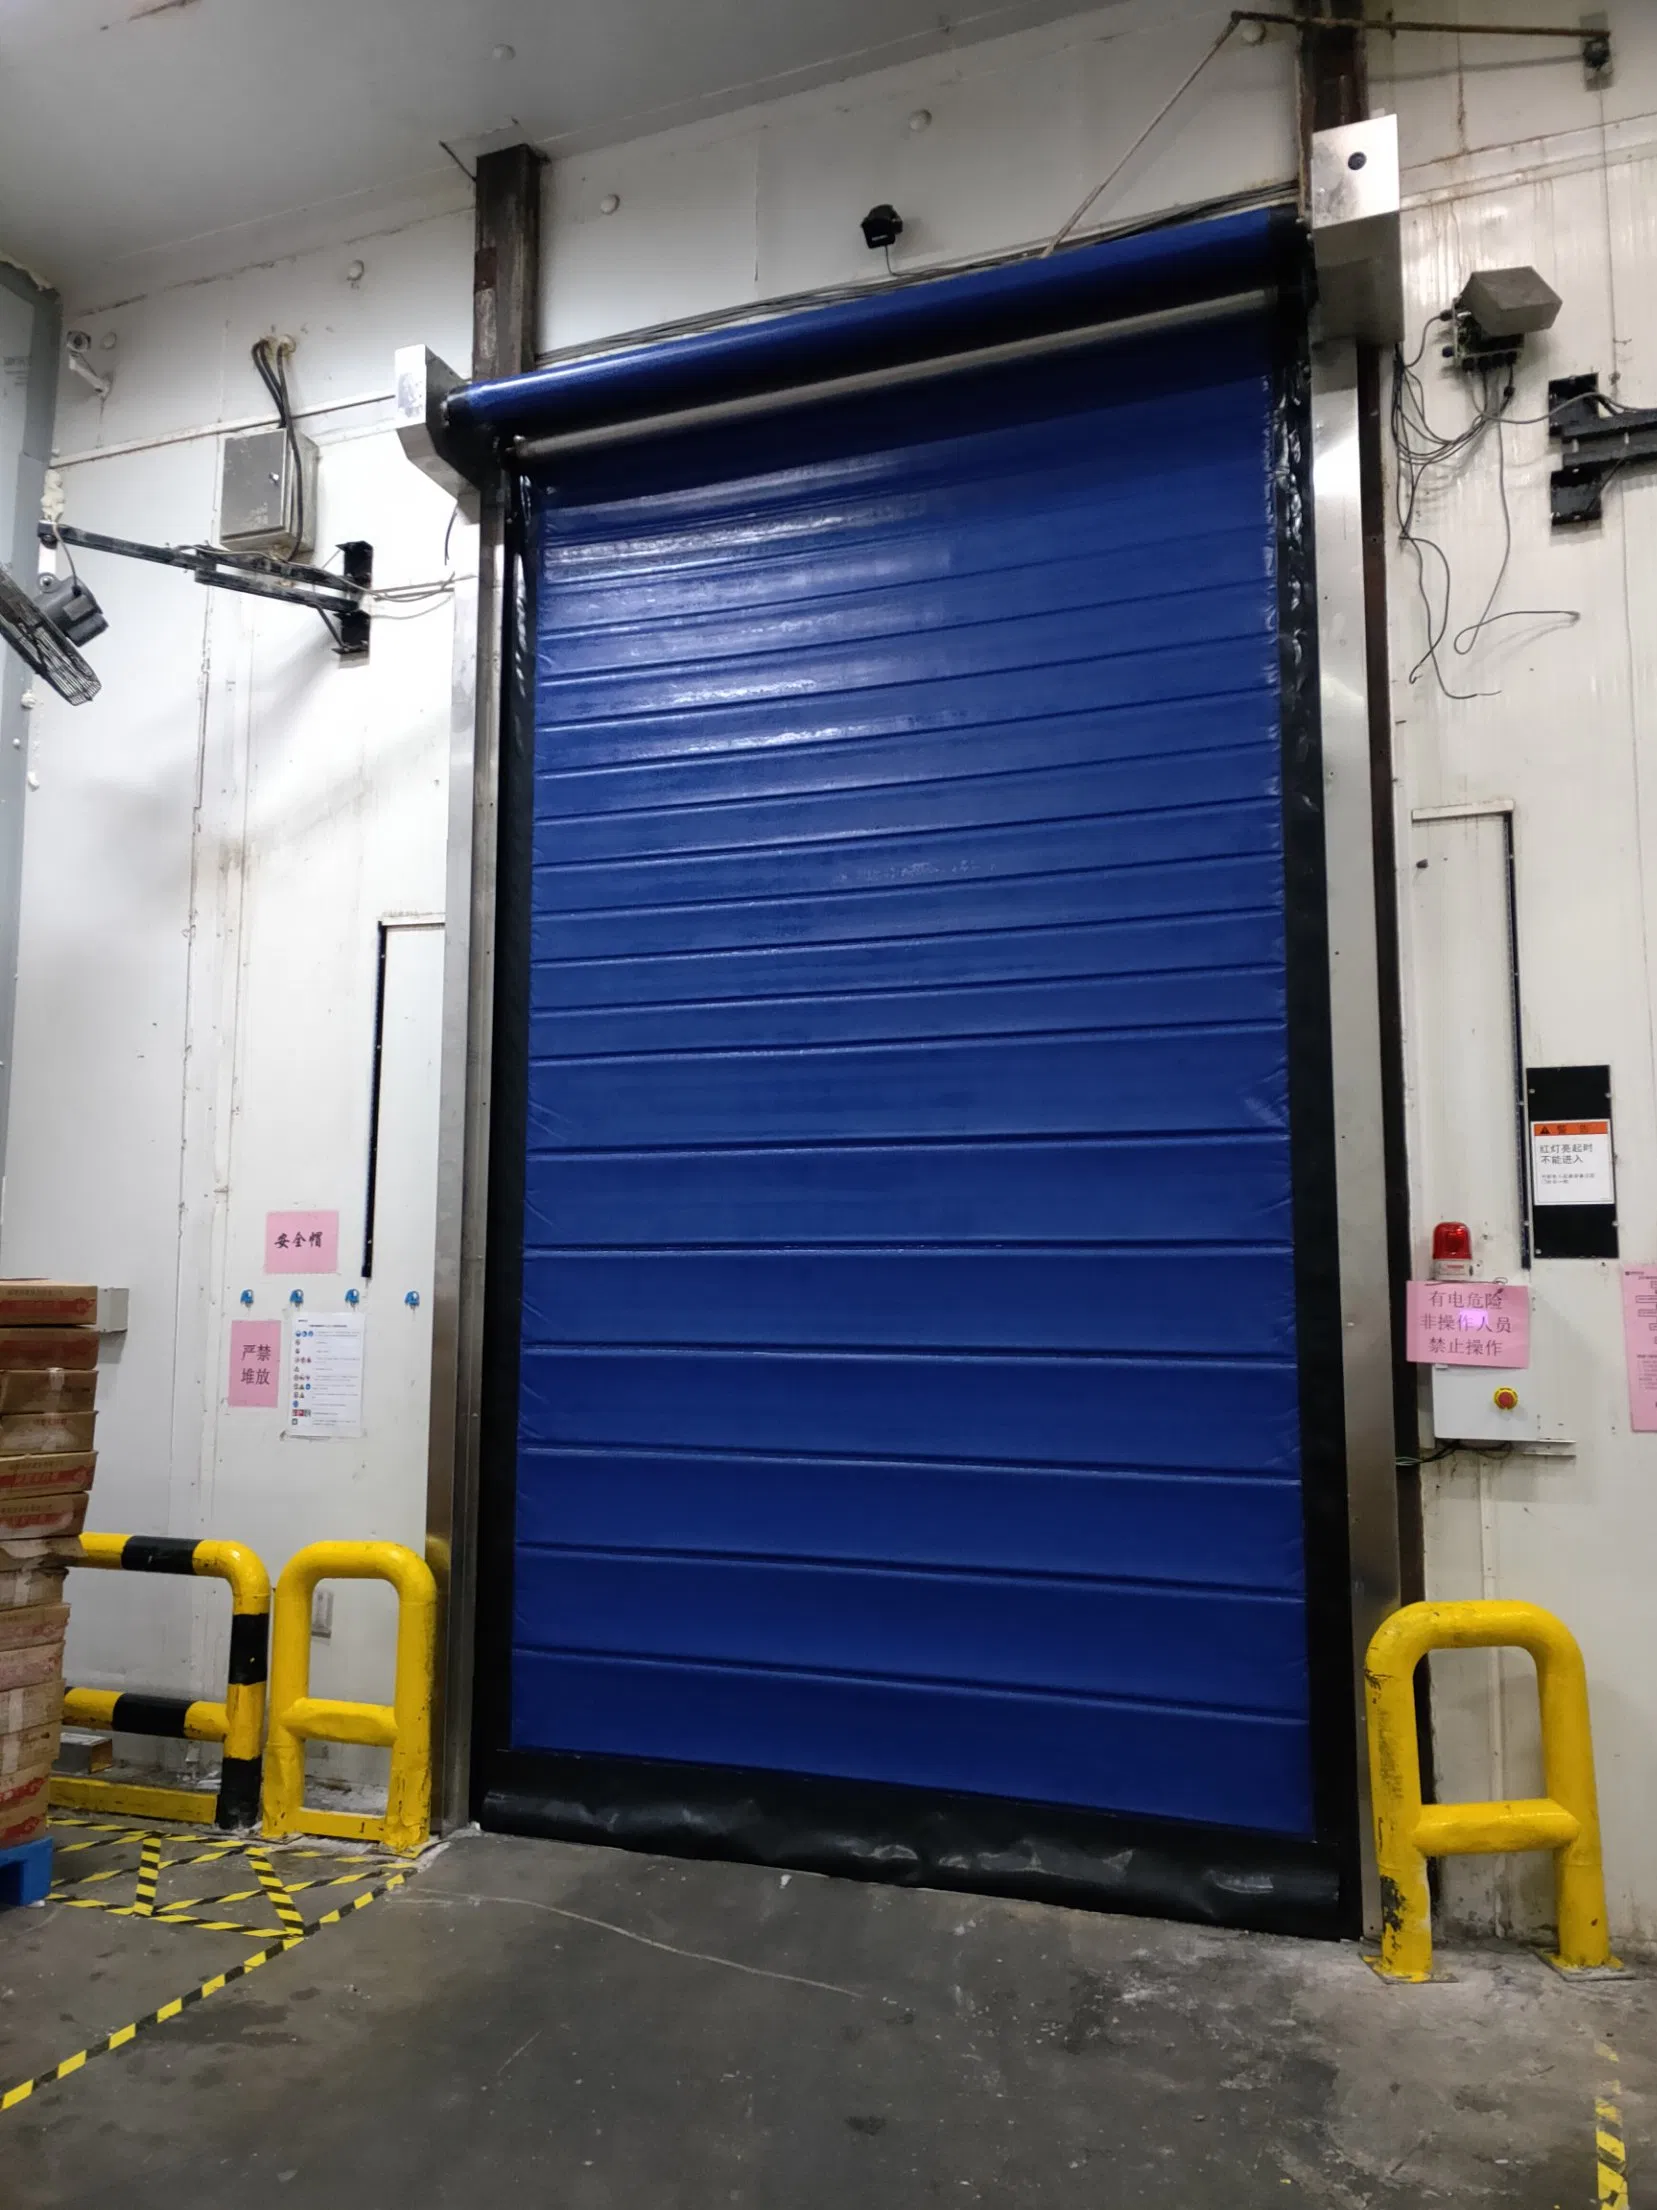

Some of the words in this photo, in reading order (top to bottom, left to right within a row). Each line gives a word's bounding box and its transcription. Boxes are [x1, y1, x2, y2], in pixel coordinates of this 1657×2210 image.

[1540, 1143, 1593, 1153] 红灯亮起时
[1541, 1154, 1583, 1165] 不能进入
[274, 1231, 323, 1249] 安全帽
[1429, 1290, 1504, 1310] 有电危险
[1421, 1313, 1512, 1334] 非操作人员
[240, 1344, 272, 1362] 严禁
[1428, 1336, 1504, 1357] 禁止操作
[240, 1367, 271, 1386] 堆放
